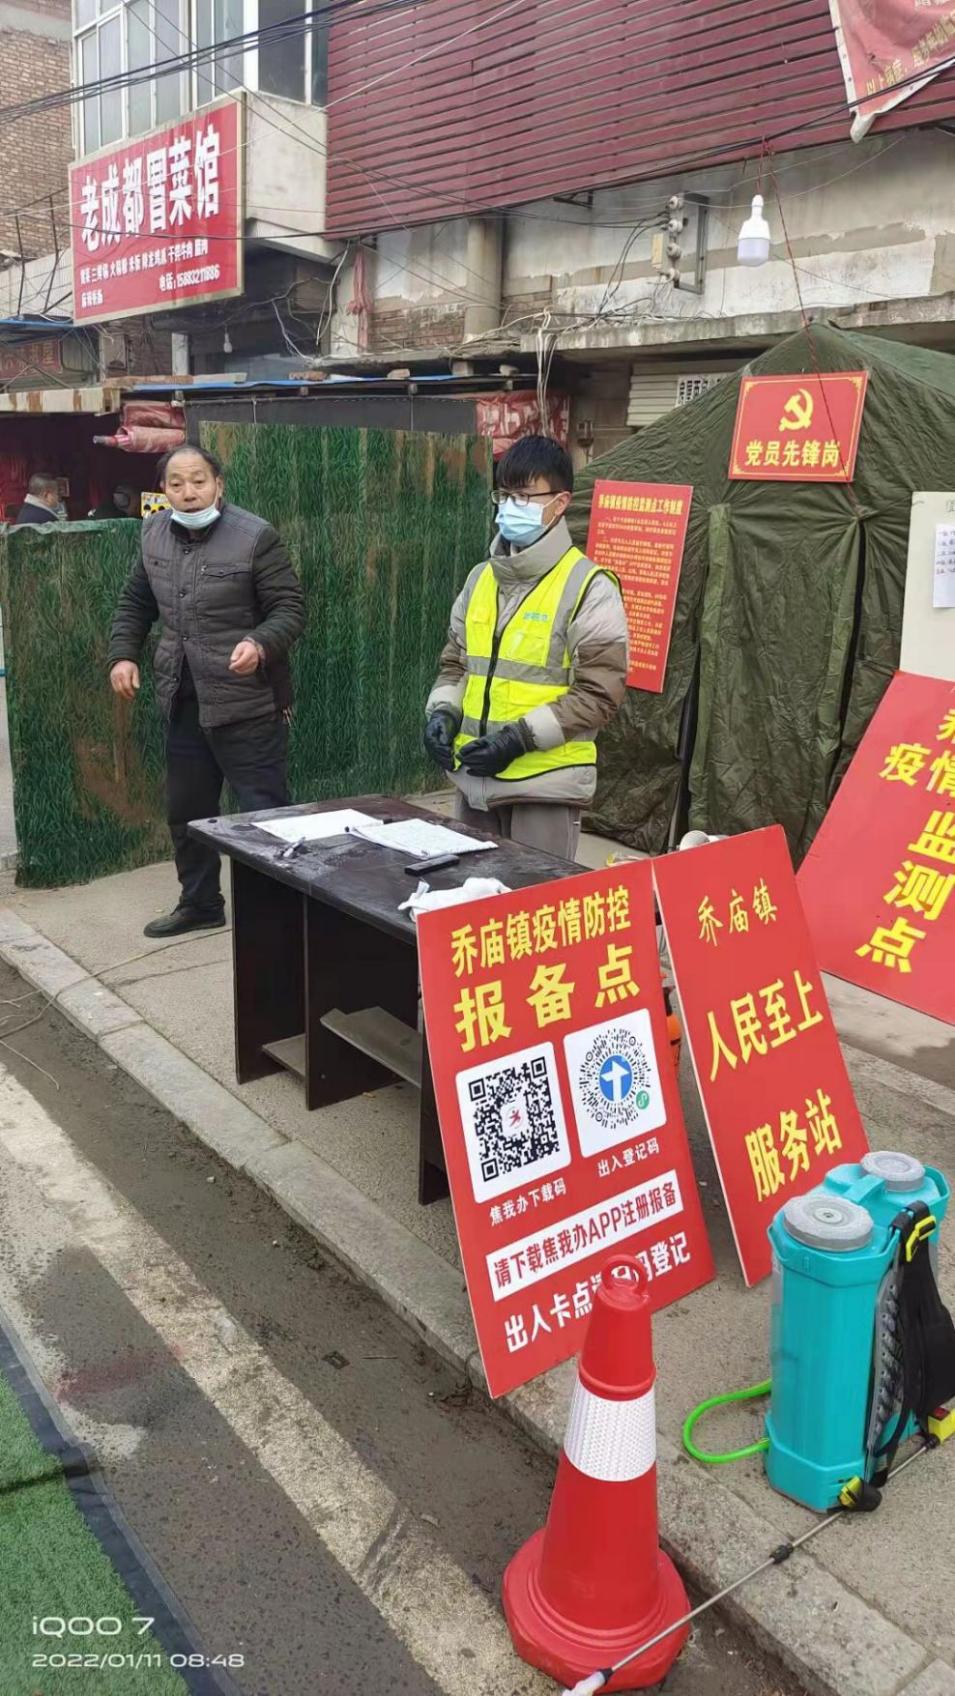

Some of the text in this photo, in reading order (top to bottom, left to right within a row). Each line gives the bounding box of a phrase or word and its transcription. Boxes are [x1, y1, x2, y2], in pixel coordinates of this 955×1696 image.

[80, 123, 220, 251] 老成都冒菜馆
[745, 439, 840, 468] 党员先锋岗
[450, 884, 632, 978] 乔庙镇疫情防控
[697, 877, 778, 947] 乔庙镇
[453, 943, 641, 1053] 报备点
[708, 969, 824, 1082] 人民至上
[597, 1136, 660, 1177] 出入登记码
[745, 1088, 844, 1203] 服务站
[489, 1177, 567, 1227] 焦我办下载码
[493, 1181, 677, 1289] 请下载焦我办APP注册报备
